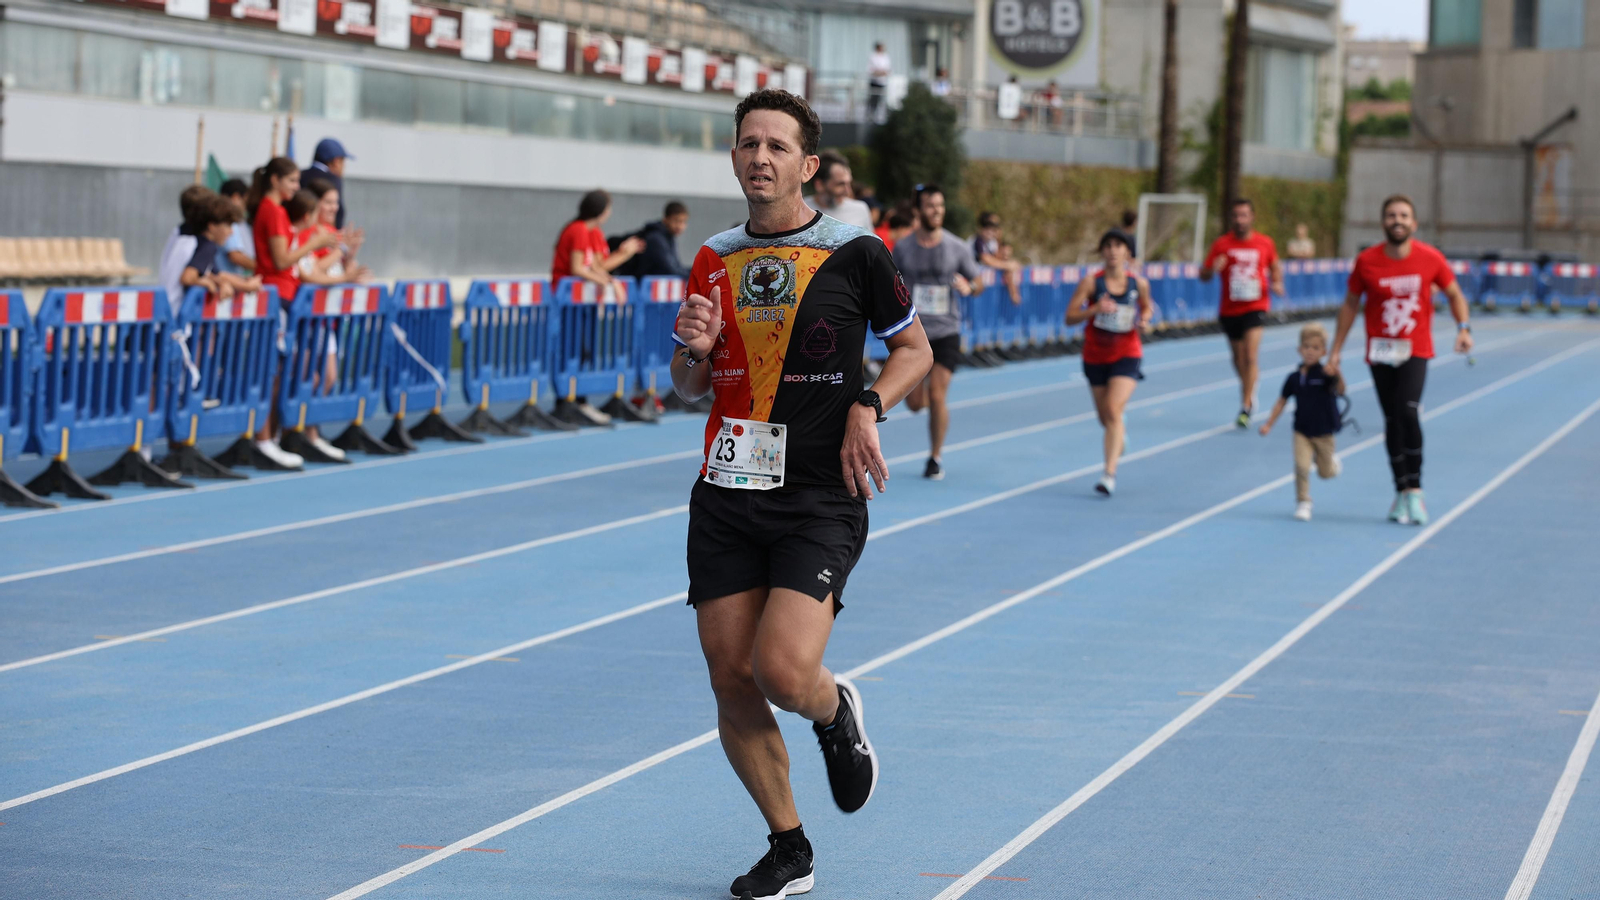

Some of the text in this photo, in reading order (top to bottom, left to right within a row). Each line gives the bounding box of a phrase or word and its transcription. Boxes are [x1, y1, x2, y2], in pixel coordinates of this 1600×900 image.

[994, 0, 1081, 36] B&B
[1004, 36, 1069, 53] HOTELS
[746, 309, 786, 323] JEREZ
[724, 368, 745, 377] ALIANO
[783, 372, 844, 382] BOX CAR
[716, 436, 736, 463] 23
